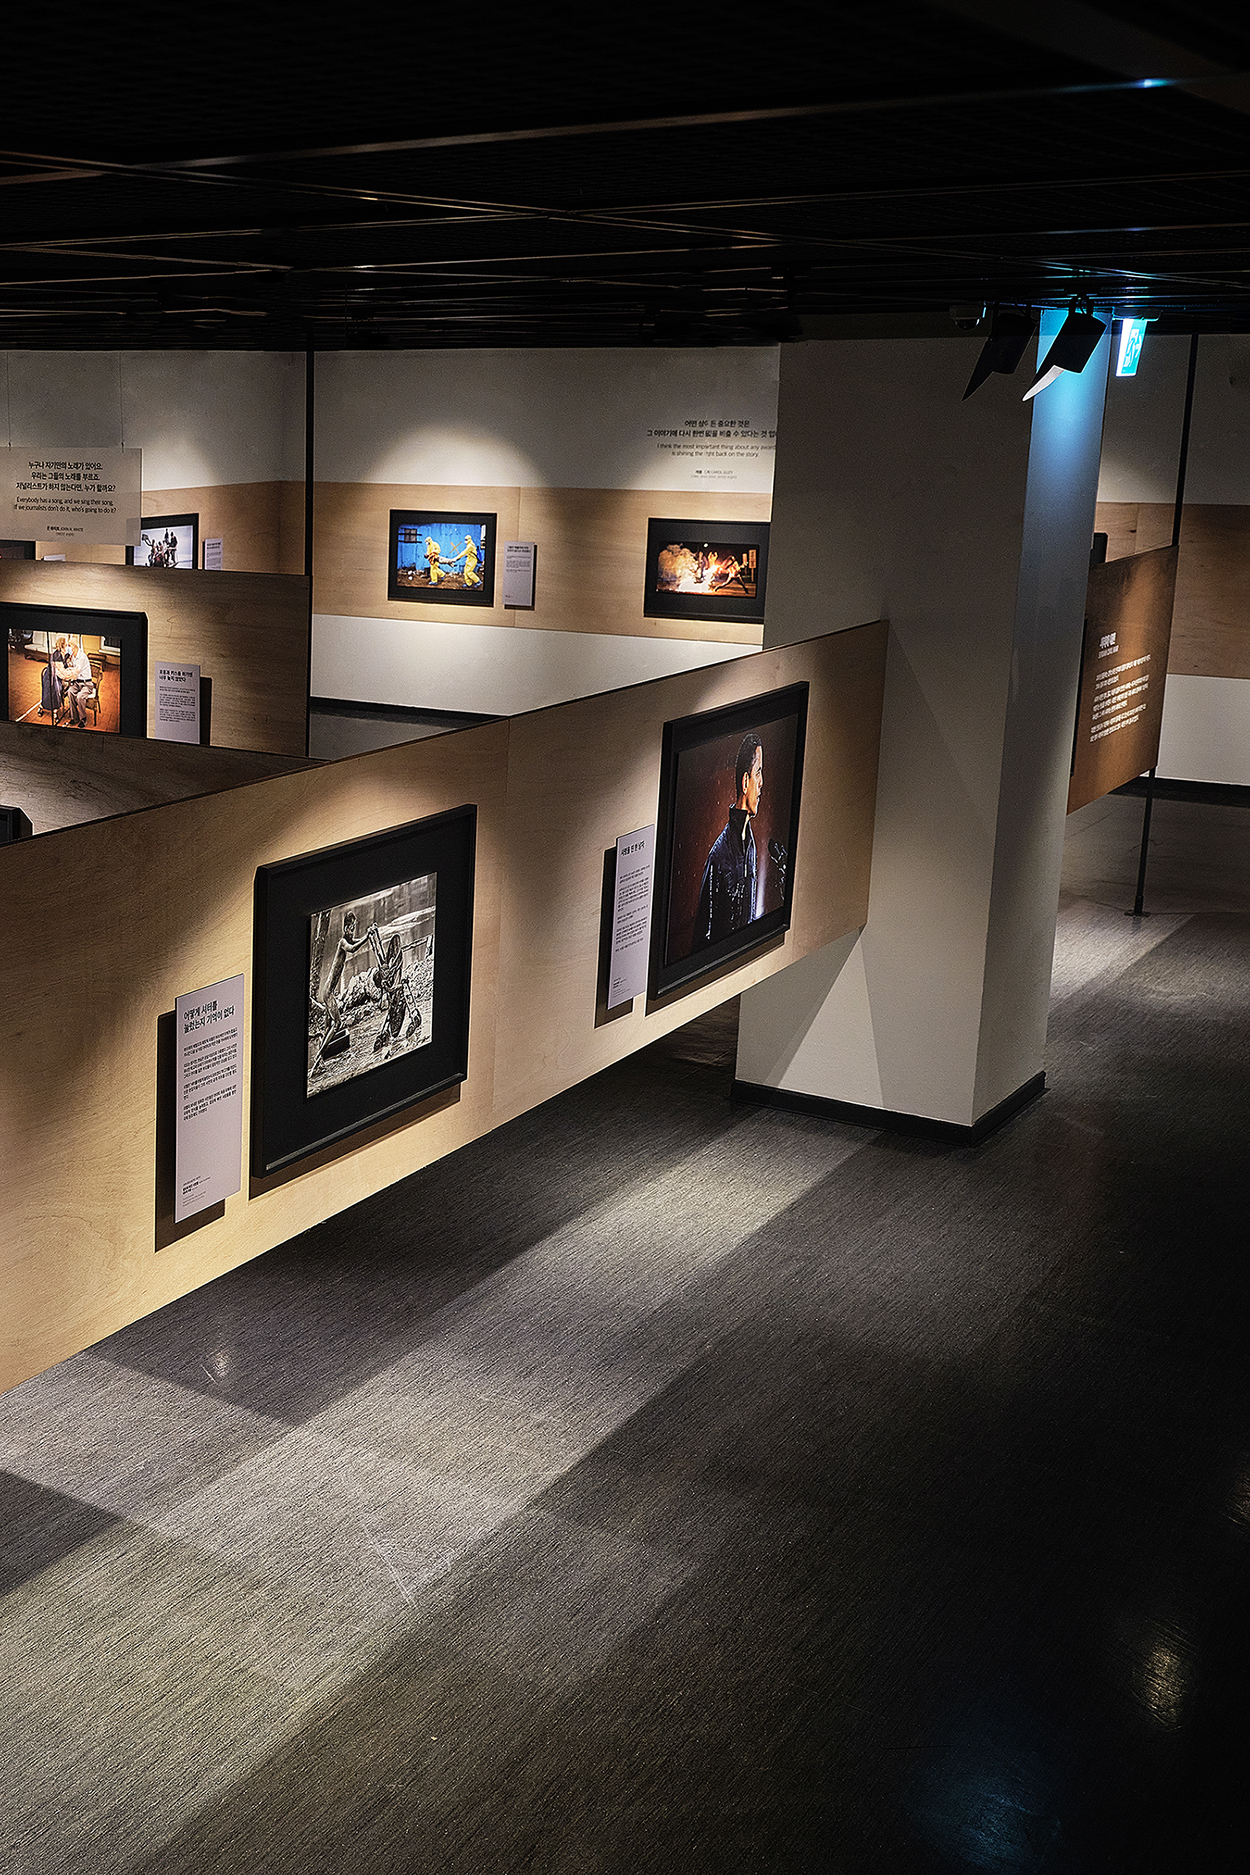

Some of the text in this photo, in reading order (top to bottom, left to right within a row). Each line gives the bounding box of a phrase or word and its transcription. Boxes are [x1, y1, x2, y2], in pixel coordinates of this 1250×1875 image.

[717, 420, 737, 428] 중요한
[737, 420, 750, 428] 것은
[28, 461, 44, 469] 누구나
[67, 462, 85, 470] 노래가
[31, 471, 47, 480] 우리는
[48, 472, 64, 480] 그들의
[65, 472, 81, 481] 노래를
[16, 482, 48, 490] 저널리스트가
[48, 482, 60, 491] 하지
[84, 484, 95, 492] 누가
[96, 484, 116, 492] 할까요?
